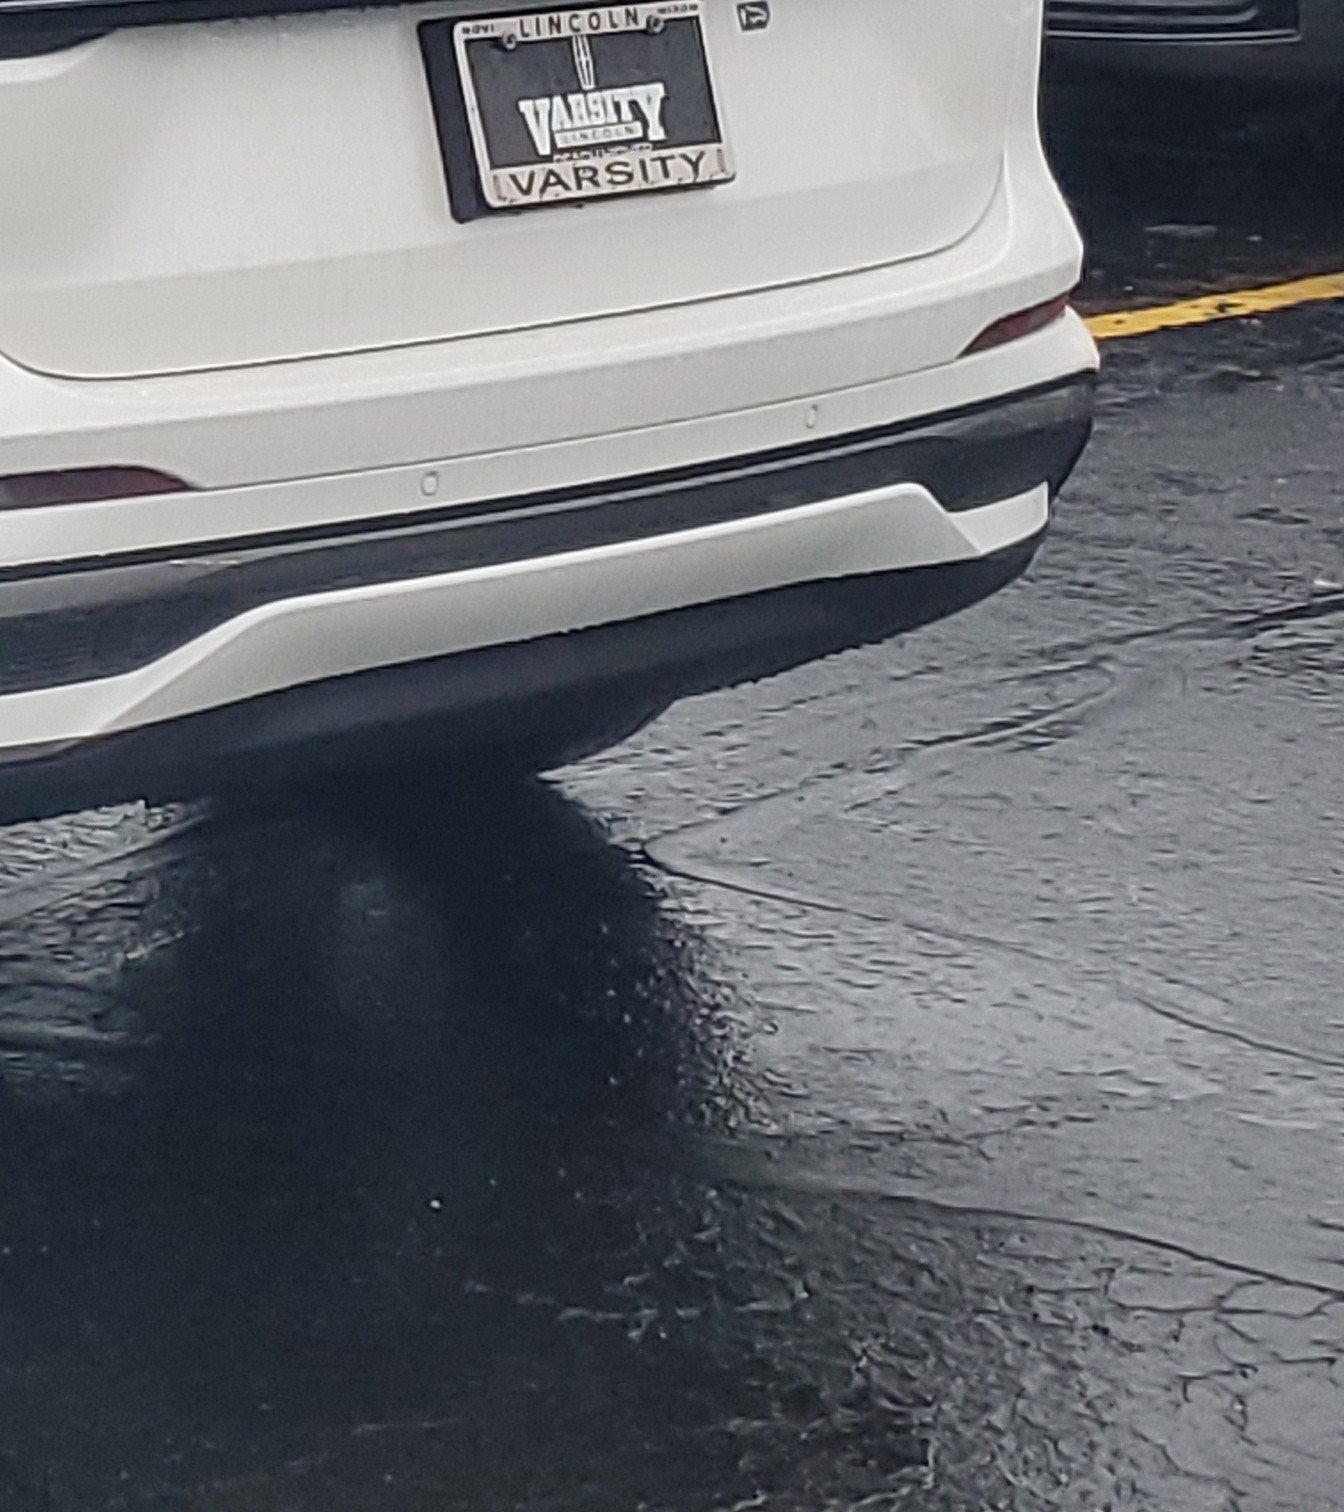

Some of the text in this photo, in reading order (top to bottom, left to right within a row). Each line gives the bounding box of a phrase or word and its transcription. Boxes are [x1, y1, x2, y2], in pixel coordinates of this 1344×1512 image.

[518, 6, 640, 39] LINCOLN
[517, 82, 666, 156] VARSITY
[508, 150, 707, 196] VARSITY
